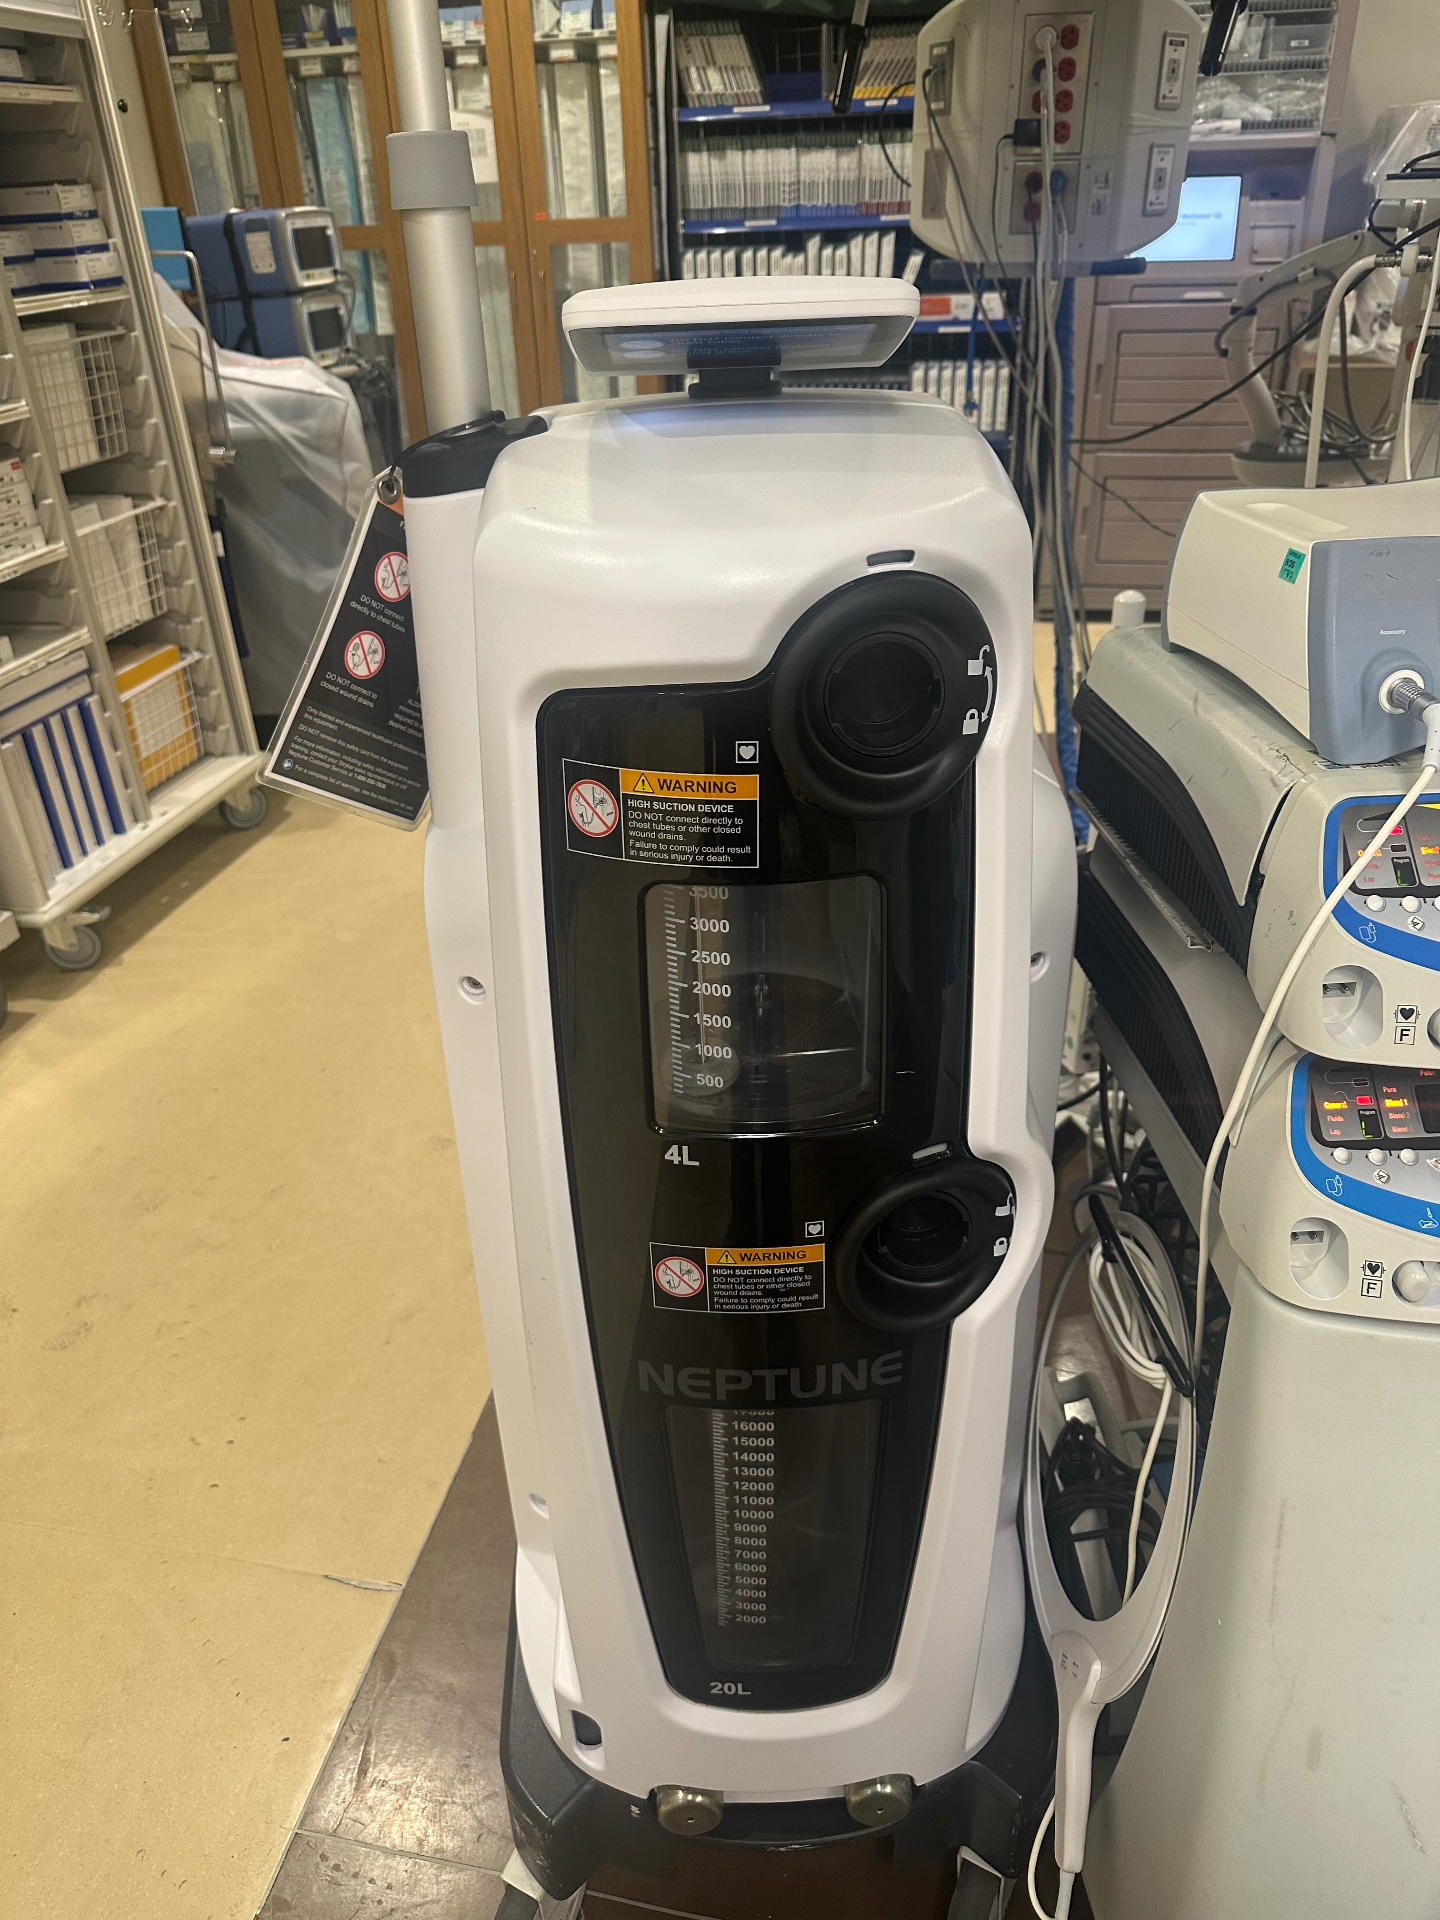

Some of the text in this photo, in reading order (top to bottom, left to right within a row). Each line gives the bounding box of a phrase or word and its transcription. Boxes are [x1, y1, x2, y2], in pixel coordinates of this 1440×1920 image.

[350, 600, 370, 614] directly
[376, 614, 391, 625] chest
[360, 594, 404, 621] DO NOT connect
[326, 672, 336, 680] DO
[337, 676, 350, 686] NOT
[350, 683, 371, 696] connect
[320, 680, 375, 707] closed wound drains.
[658, 778, 737, 794] WARNING
[628, 799, 734, 813] HIGH SUCTION DEVICE
[628, 811, 743, 826] DO NOT connect directly to
[629, 821, 650, 829] chest
[653, 823, 675, 831] tubes
[689, 825, 710, 833] other
[713, 826, 741, 834] closed
[629, 830, 686, 840] wound drains.
[630, 840, 657, 849] Failure
[670, 844, 699, 854] comply
[701, 845, 725, 853] could
[727, 846, 751, 854] result
[639, 850, 669, 859] serious
[671, 852, 694, 862] injury
[707, 854, 733, 862] death.
[689, 886, 729, 900] 3500
[690, 916, 730, 933] 3000
[691, 950, 731, 966] 2500
[692, 981, 732, 997] 2000
[694, 1013, 731, 1029] 1500
[1400, 1029, 1410, 1041] F
[695, 1043, 732, 1059] 1000
[696, 1073, 724, 1088] 500
[664, 1144, 699, 1166] 4L
[739, 1250, 806, 1261] WARNING
[1367, 1282, 1377, 1294] F
[637, 1349, 903, 1401] NEPTUNE
[732, 1421, 774, 1431] 16000
[732, 1436, 774, 1446] 15000
[732, 1451, 774, 1462] 14000
[732, 1466, 774, 1476] 13000
[733, 1481, 774, 1491] 12000
[733, 1495, 774, 1505] 11000
[734, 1509, 774, 1518] 10000
[734, 1523, 767, 1532] 9000
[734, 1536, 767, 1546] 8000
[734, 1549, 767, 1559] 7000
[735, 1563, 767, 1572] 6000
[735, 1576, 767, 1585] 5000
[735, 1588, 766, 1598] 4000
[735, 1601, 766, 1611] 3000
[735, 1614, 766, 1624] 2000
[710, 1681, 751, 1695] 20L
